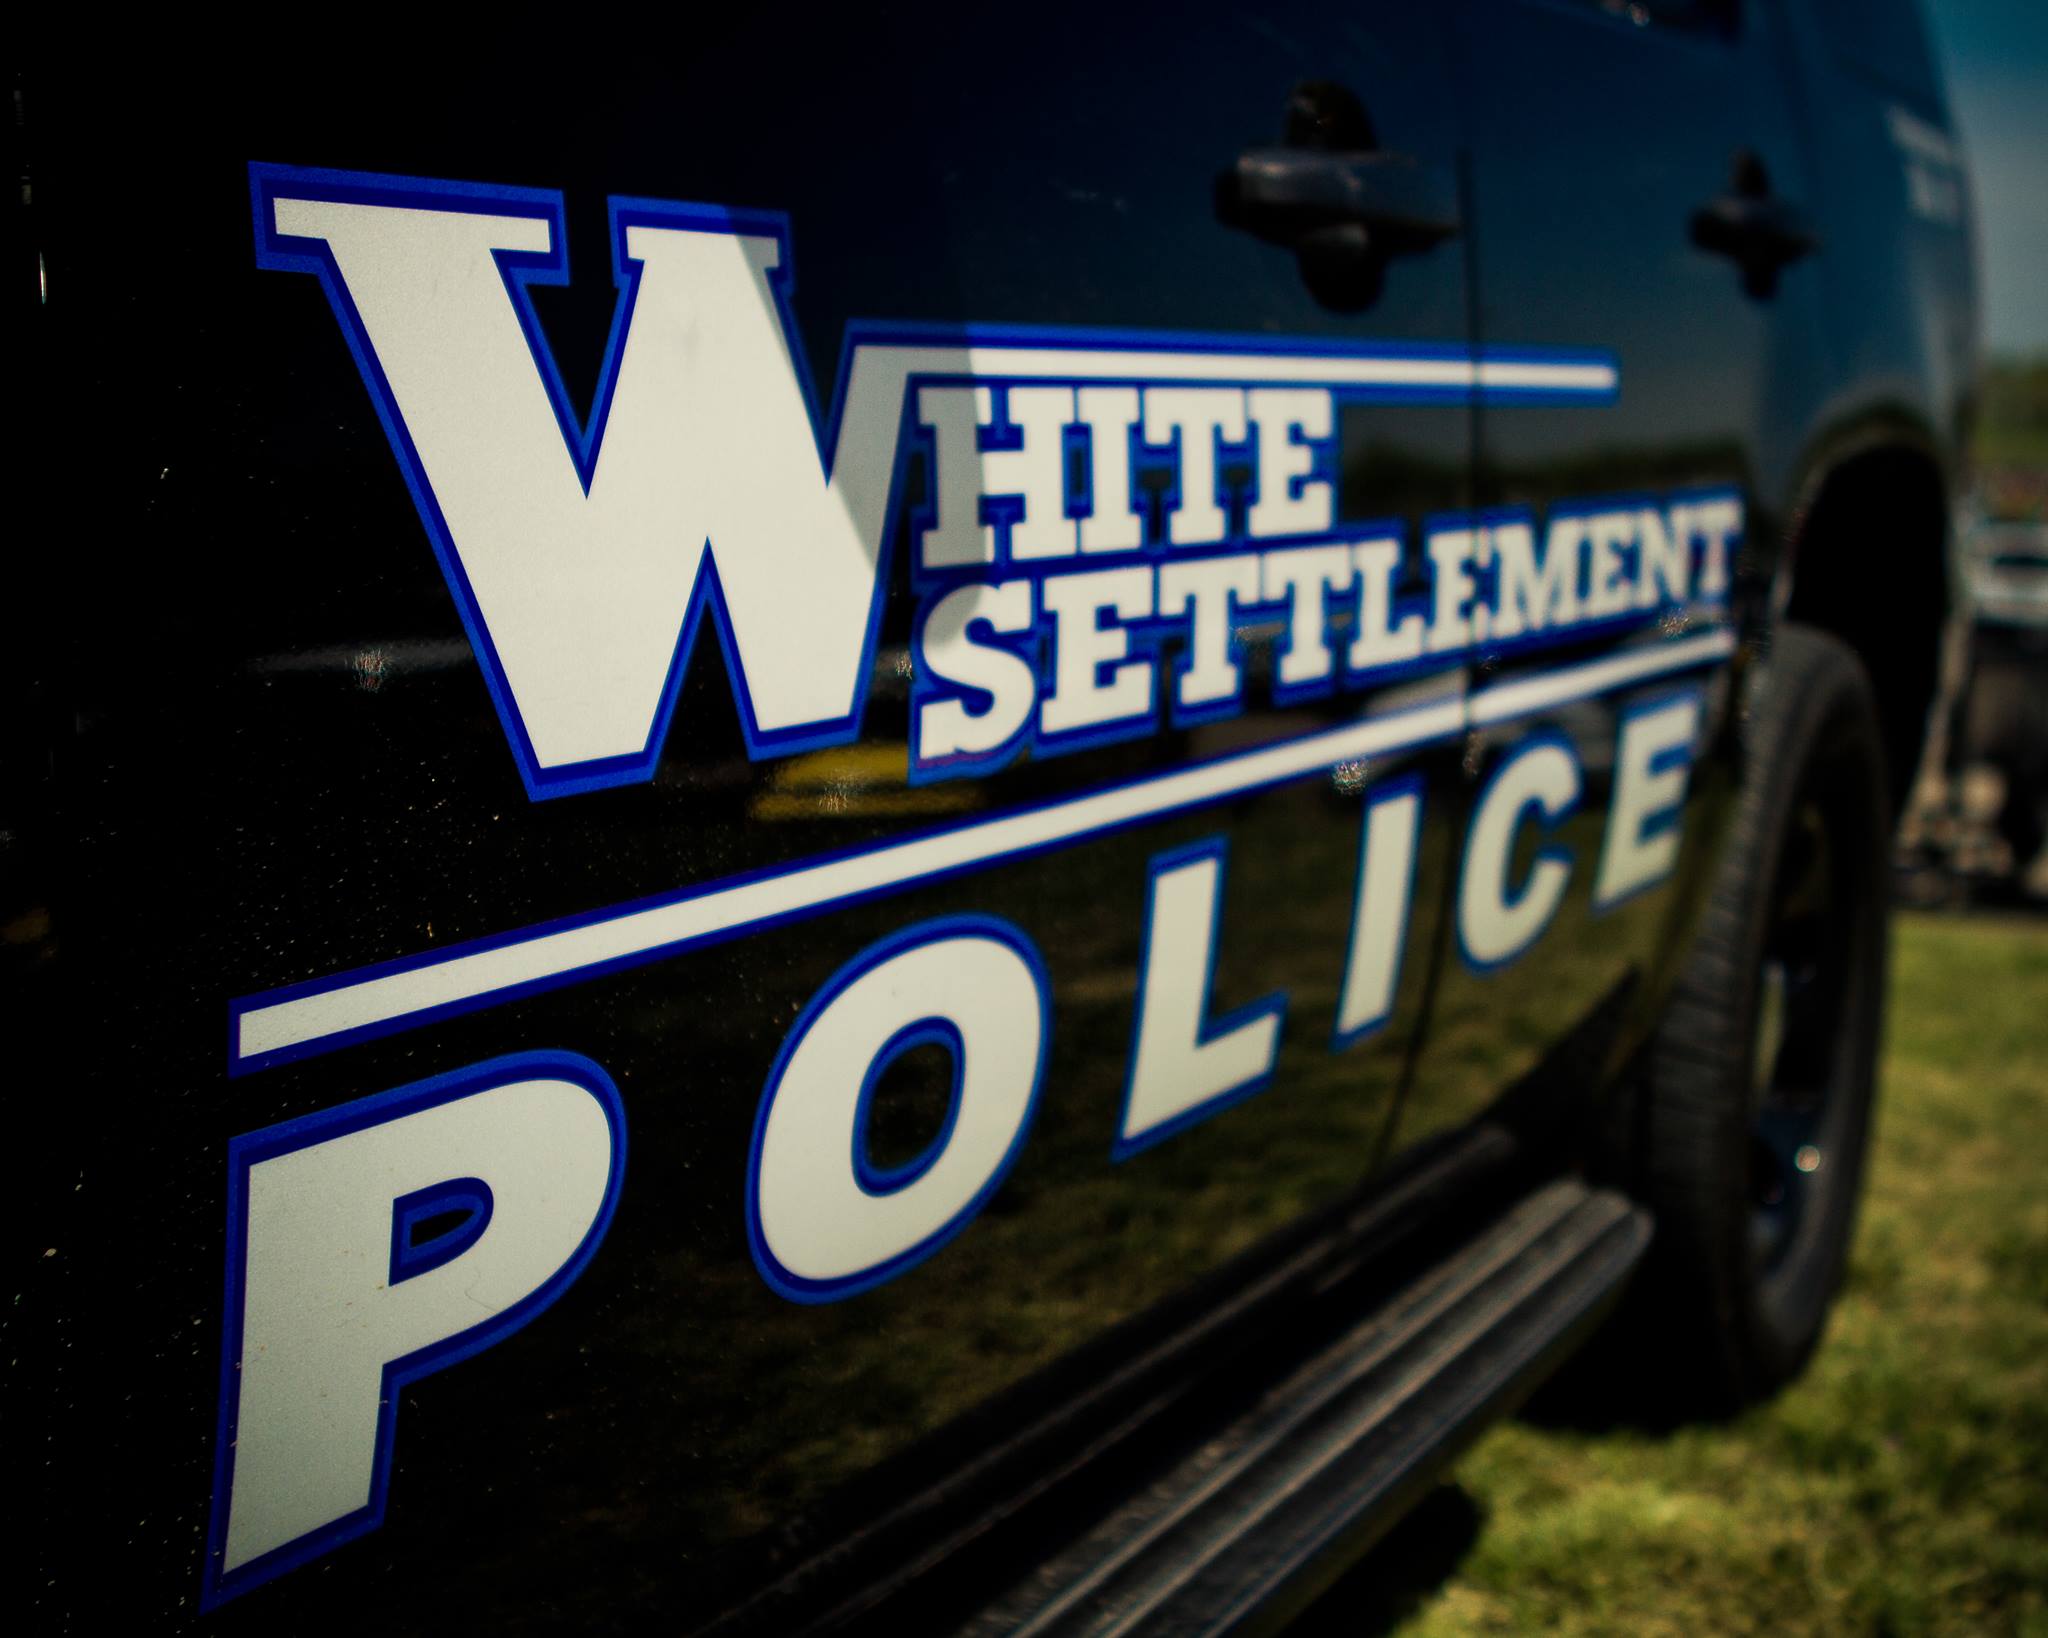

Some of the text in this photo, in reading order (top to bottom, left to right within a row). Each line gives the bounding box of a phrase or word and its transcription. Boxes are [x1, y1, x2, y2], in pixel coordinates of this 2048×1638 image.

[252, 164, 1338, 798] WHITE
[910, 492, 1742, 780] SETTLEMENT
[206, 690, 1702, 1606] POLICE
